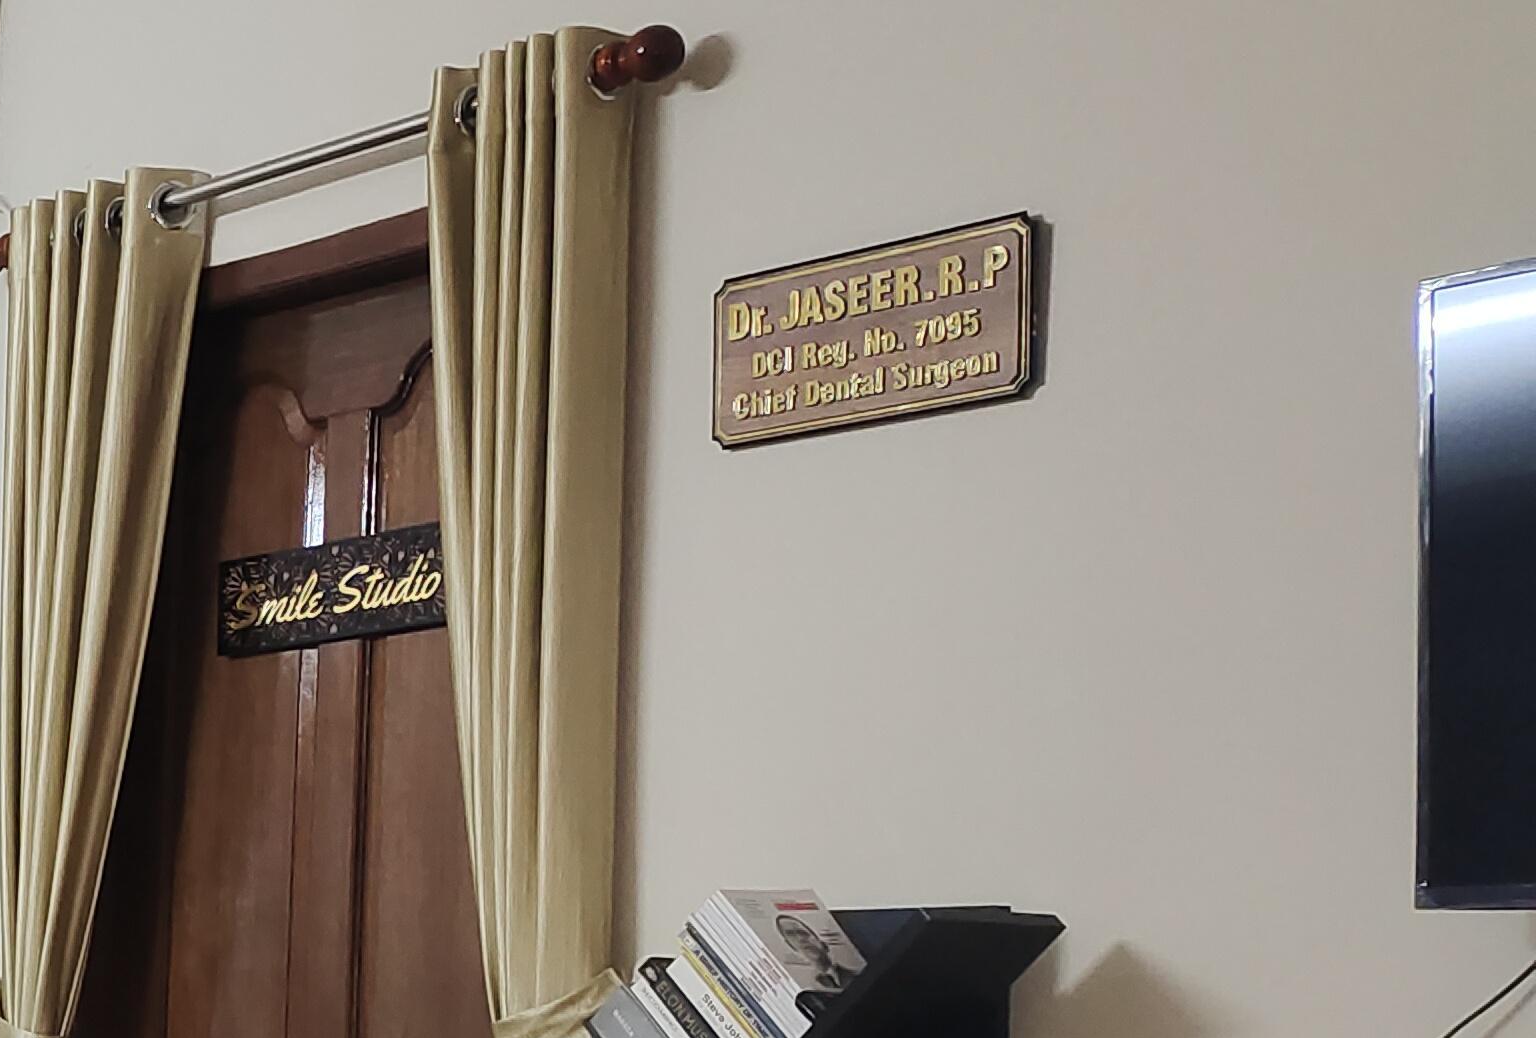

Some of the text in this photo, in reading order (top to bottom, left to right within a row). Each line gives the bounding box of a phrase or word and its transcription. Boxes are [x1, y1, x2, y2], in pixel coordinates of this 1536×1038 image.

[728, 301, 774, 342] Dr.
[802, 340, 856, 371] Reg.
[863, 326, 904, 357] No.
[913, 308, 982, 348] 7095
[732, 350, 1001, 421] Chief Dental Surgeon
[227, 553, 443, 631] Smile Studio
[653, 979, 689, 1017] ELON
[700, 992, 727, 1024] Steve
